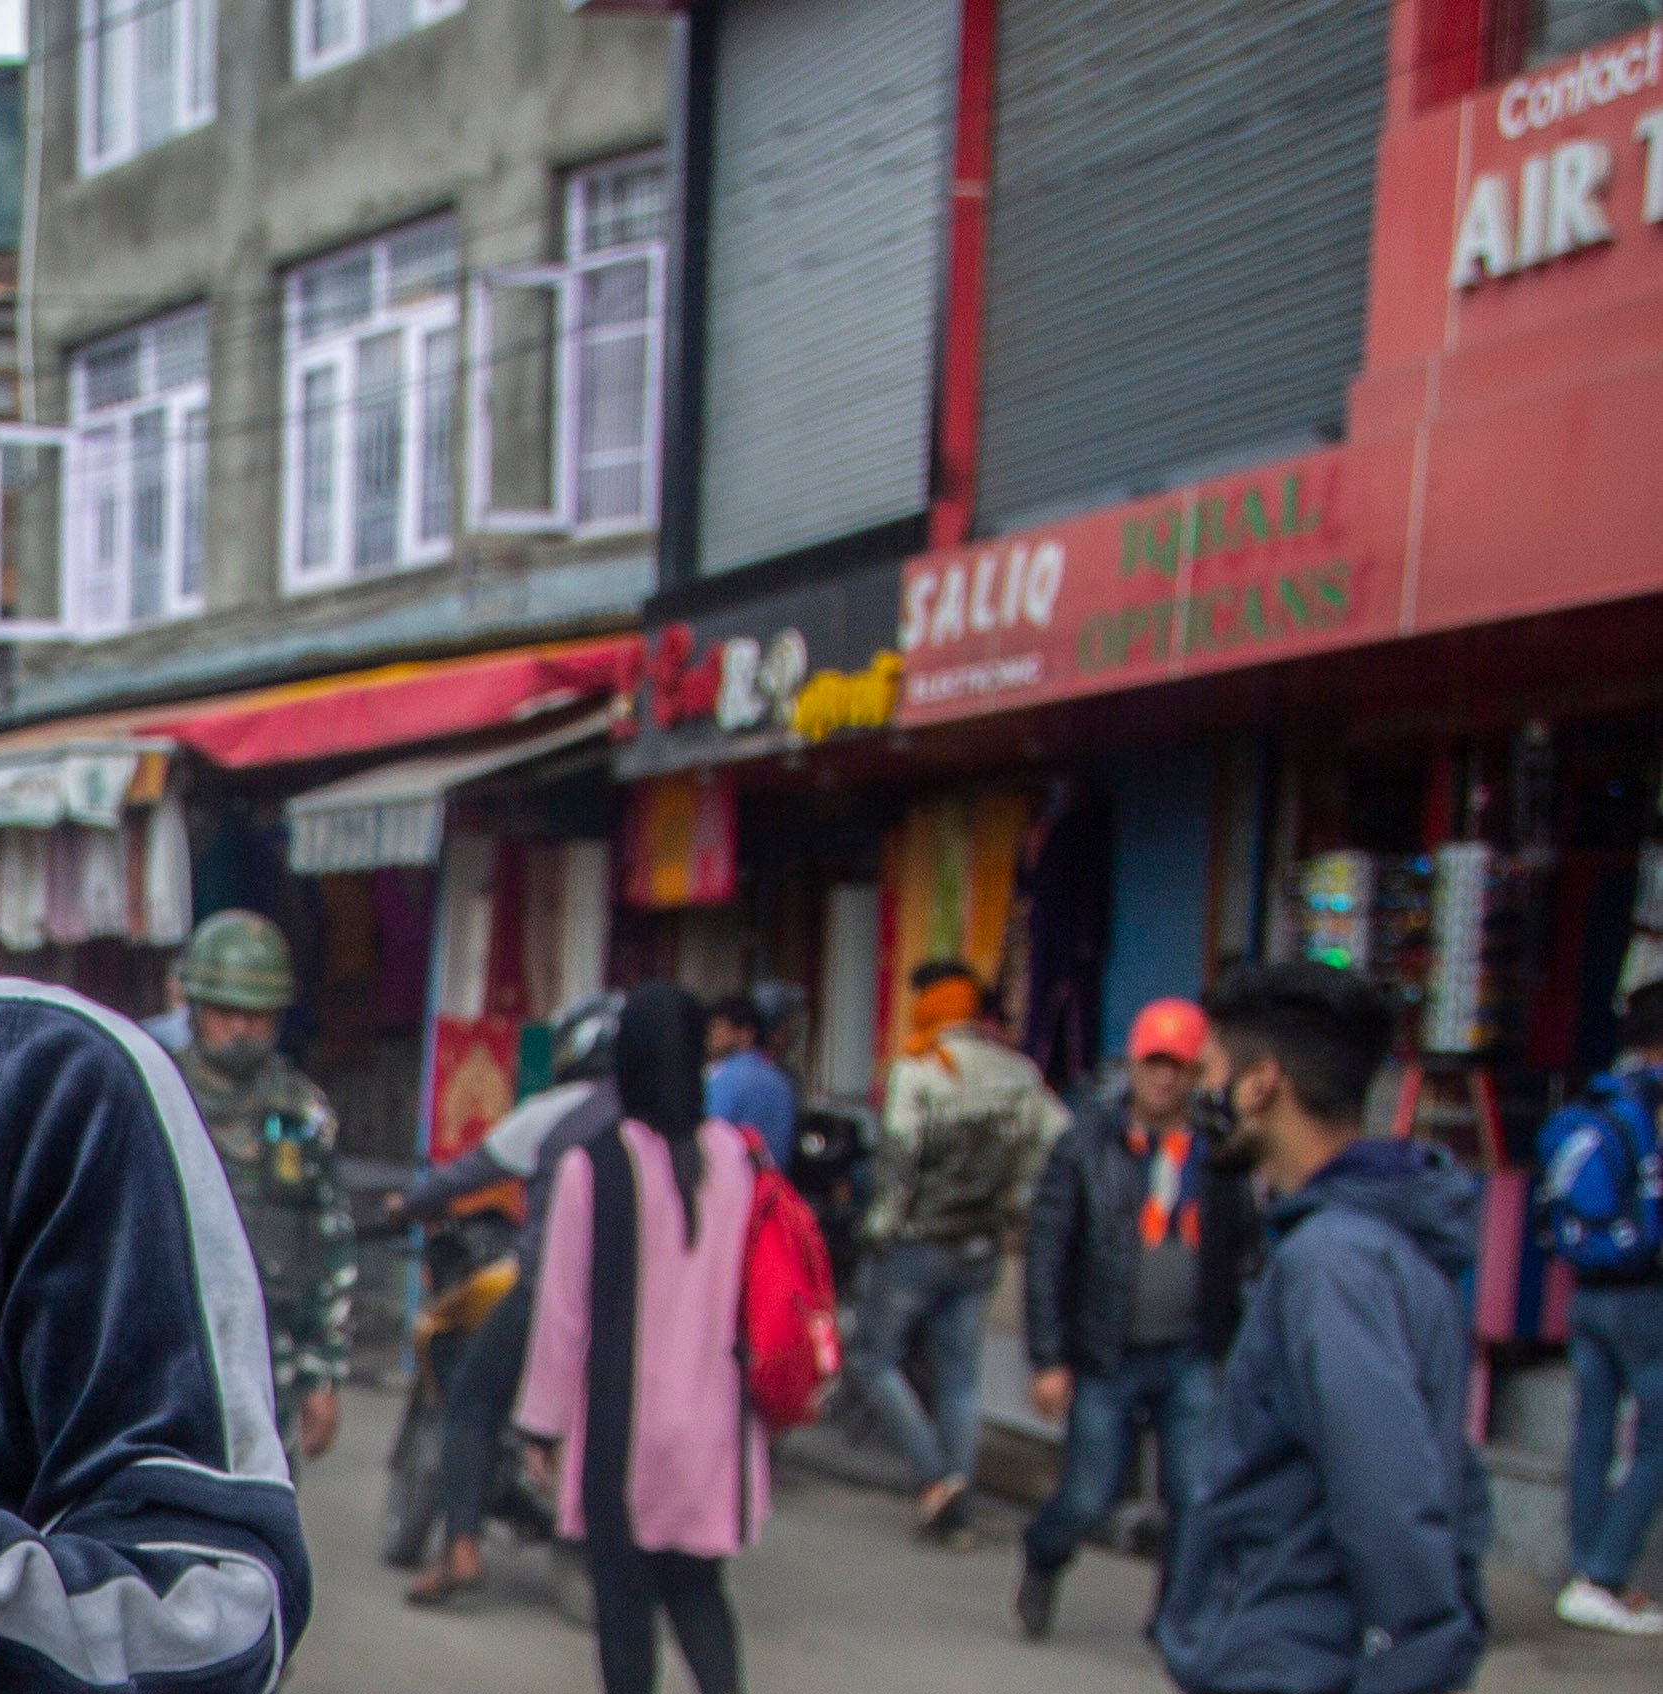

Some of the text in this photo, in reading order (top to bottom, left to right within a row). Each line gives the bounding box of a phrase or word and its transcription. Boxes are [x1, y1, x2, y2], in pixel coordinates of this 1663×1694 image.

[1450, 140, 1615, 289] AIR
[1120, 473, 1322, 578] IQBAL
[899, 541, 1066, 652] SALIQ
